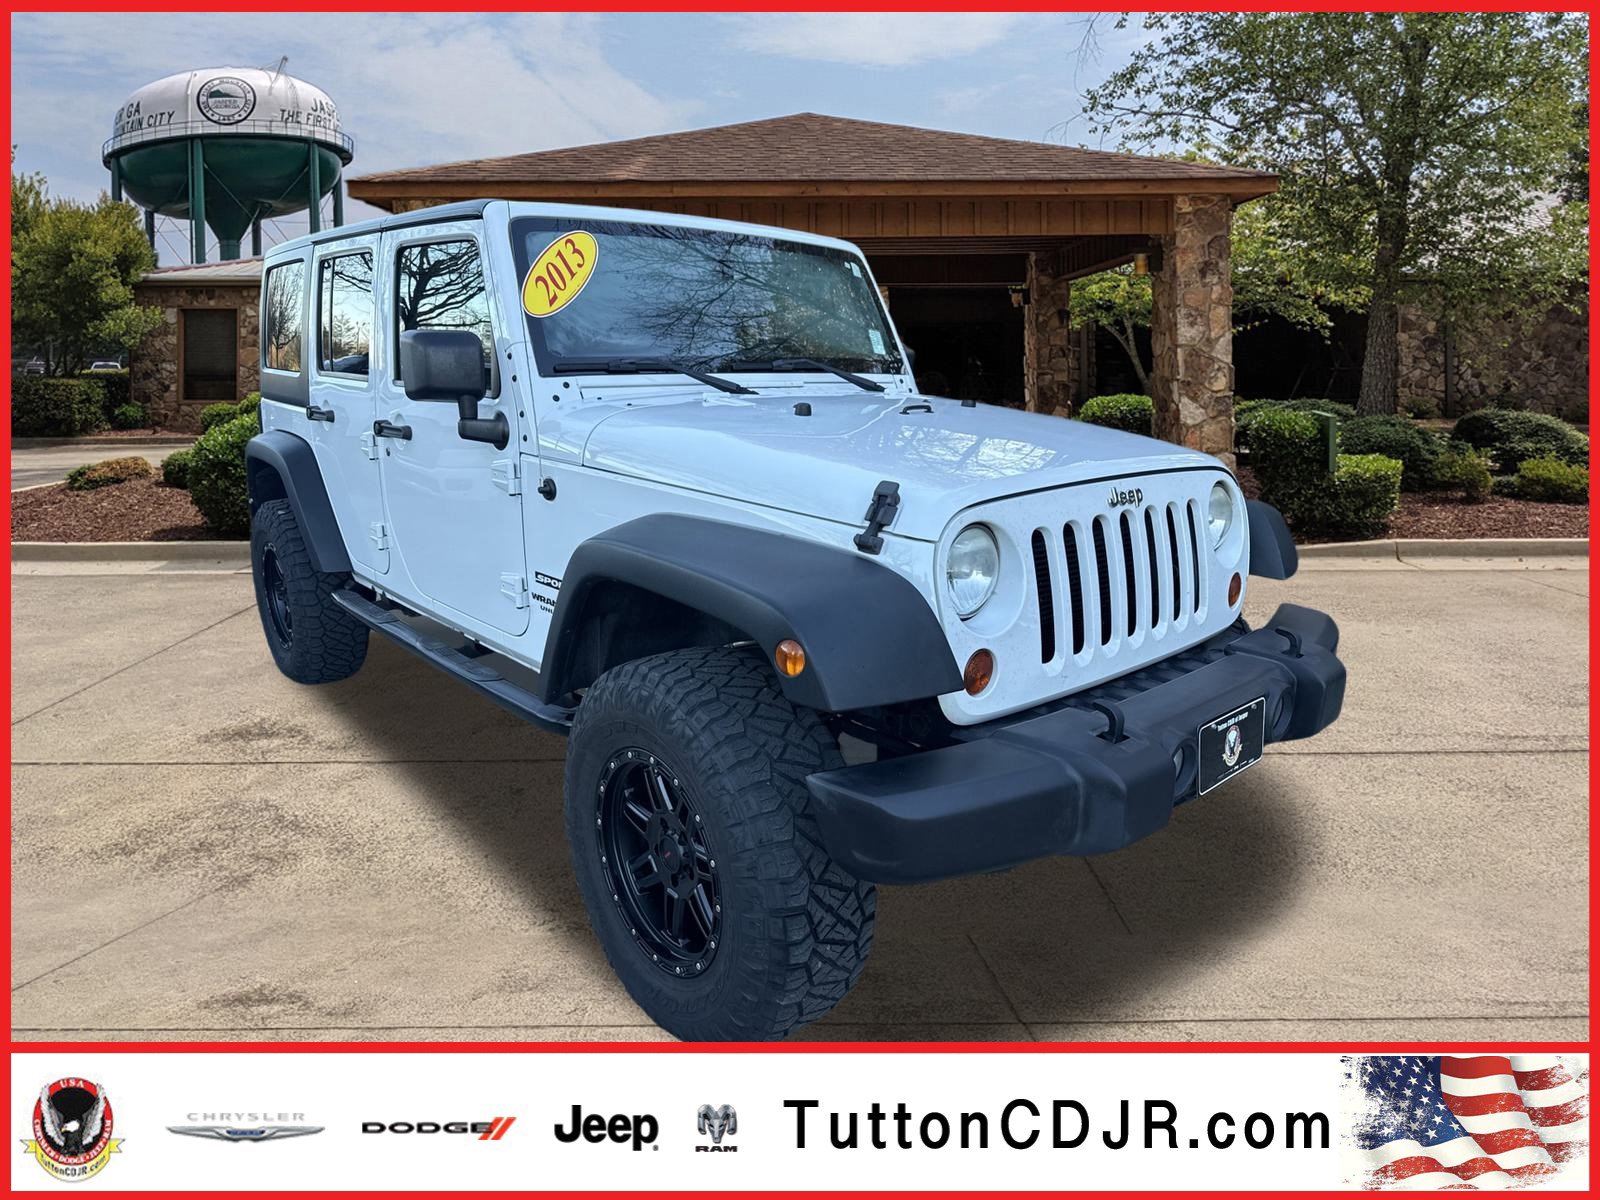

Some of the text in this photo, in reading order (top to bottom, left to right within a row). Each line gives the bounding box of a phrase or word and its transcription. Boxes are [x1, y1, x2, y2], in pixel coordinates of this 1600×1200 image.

[126, 101, 140, 119] GA
[147, 110, 175, 127] CITY
[279, 108, 302, 124] THE
[535, 238, 585, 307] 2013
[1107, 486, 1143, 508] Jeep
